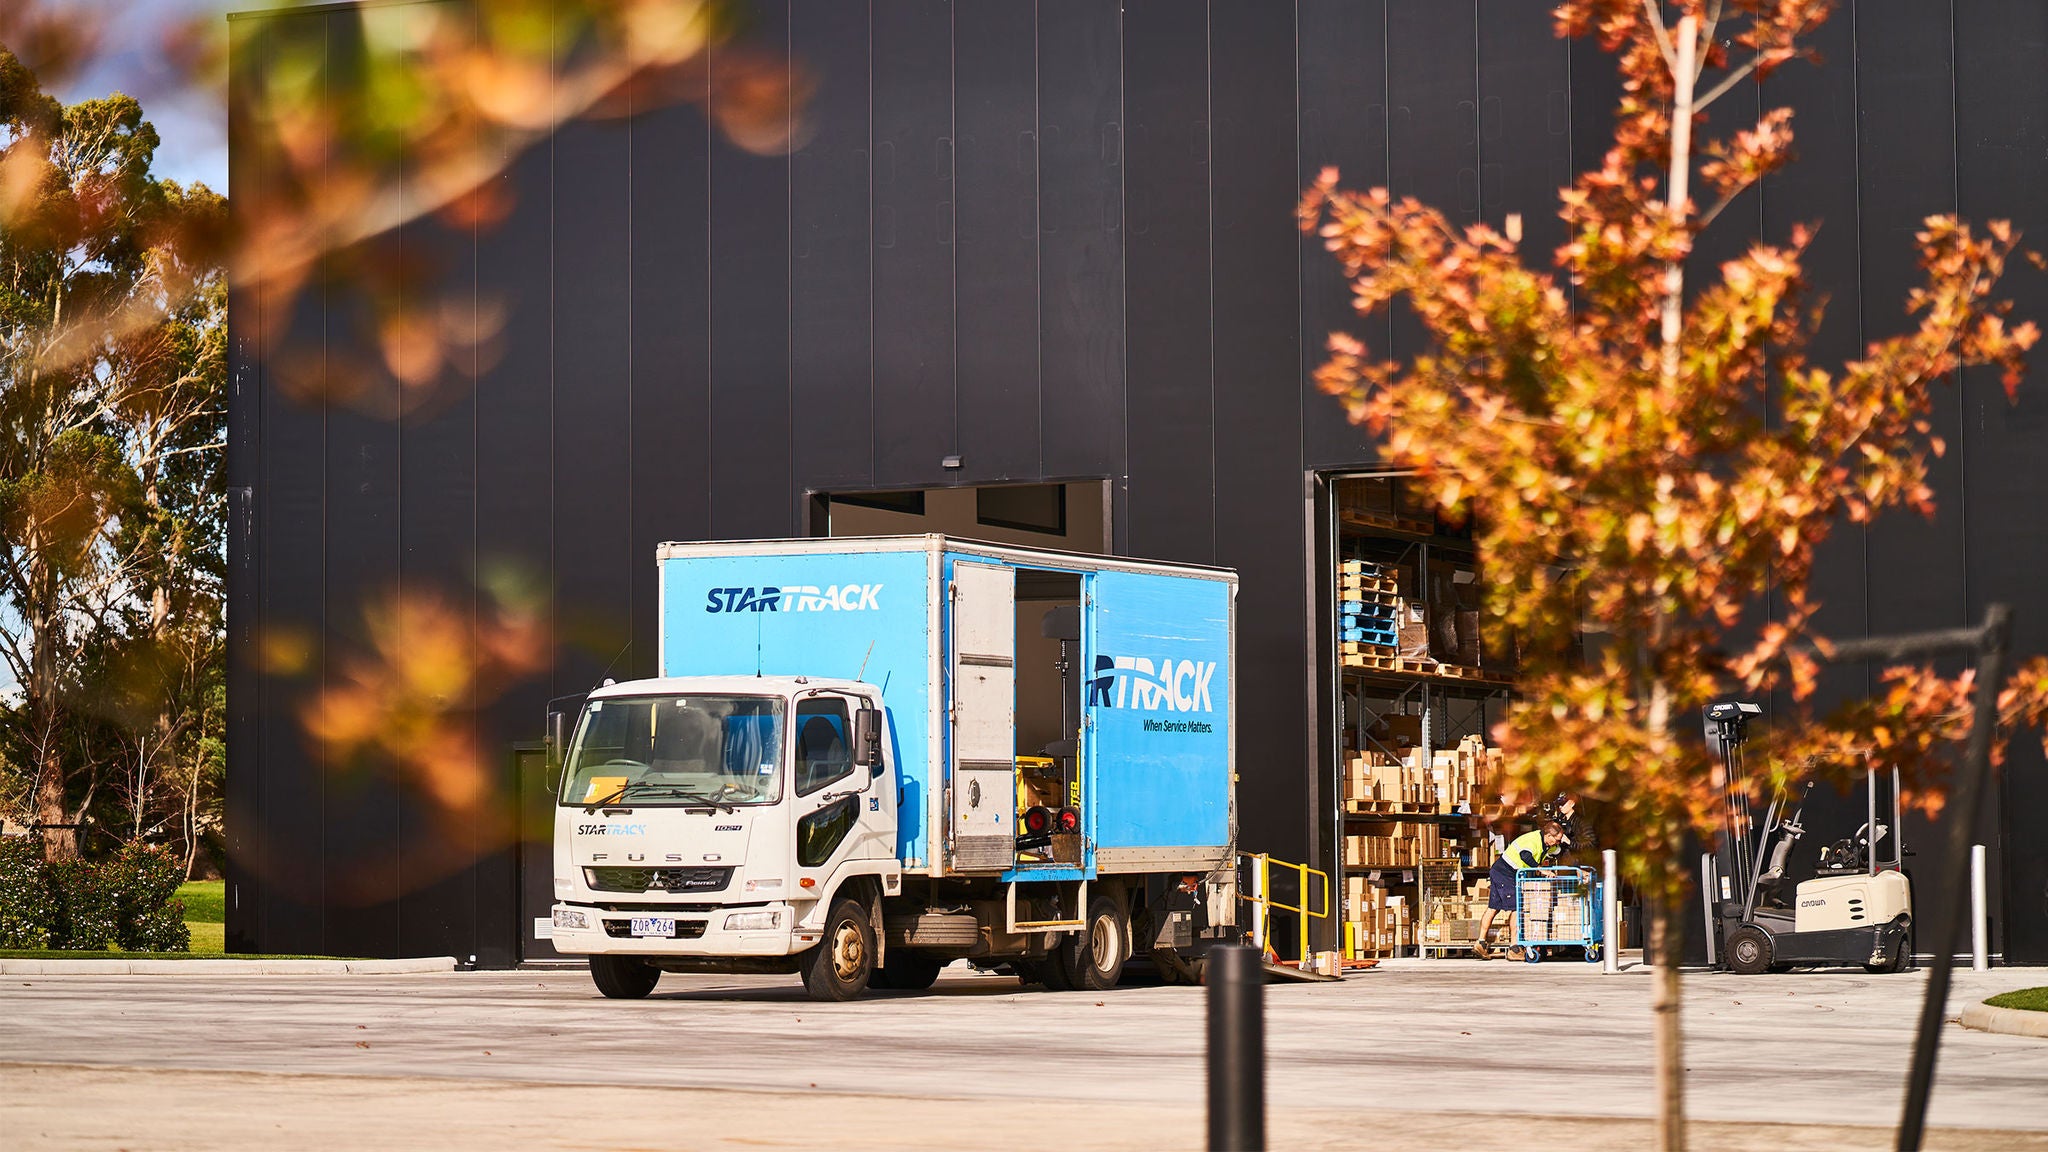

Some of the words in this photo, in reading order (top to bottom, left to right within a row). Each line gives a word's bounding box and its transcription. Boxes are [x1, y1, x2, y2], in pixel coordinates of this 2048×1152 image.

[705, 583, 884, 613] STARTRACK
[1143, 719, 1163, 732] When
[1163, 720, 1187, 732] Service
[1187, 720, 1213, 733] Matters.
[578, 824, 647, 836] STARTRACK
[592, 853, 722, 862] FUSO
[656, 920, 674, 932] 264
